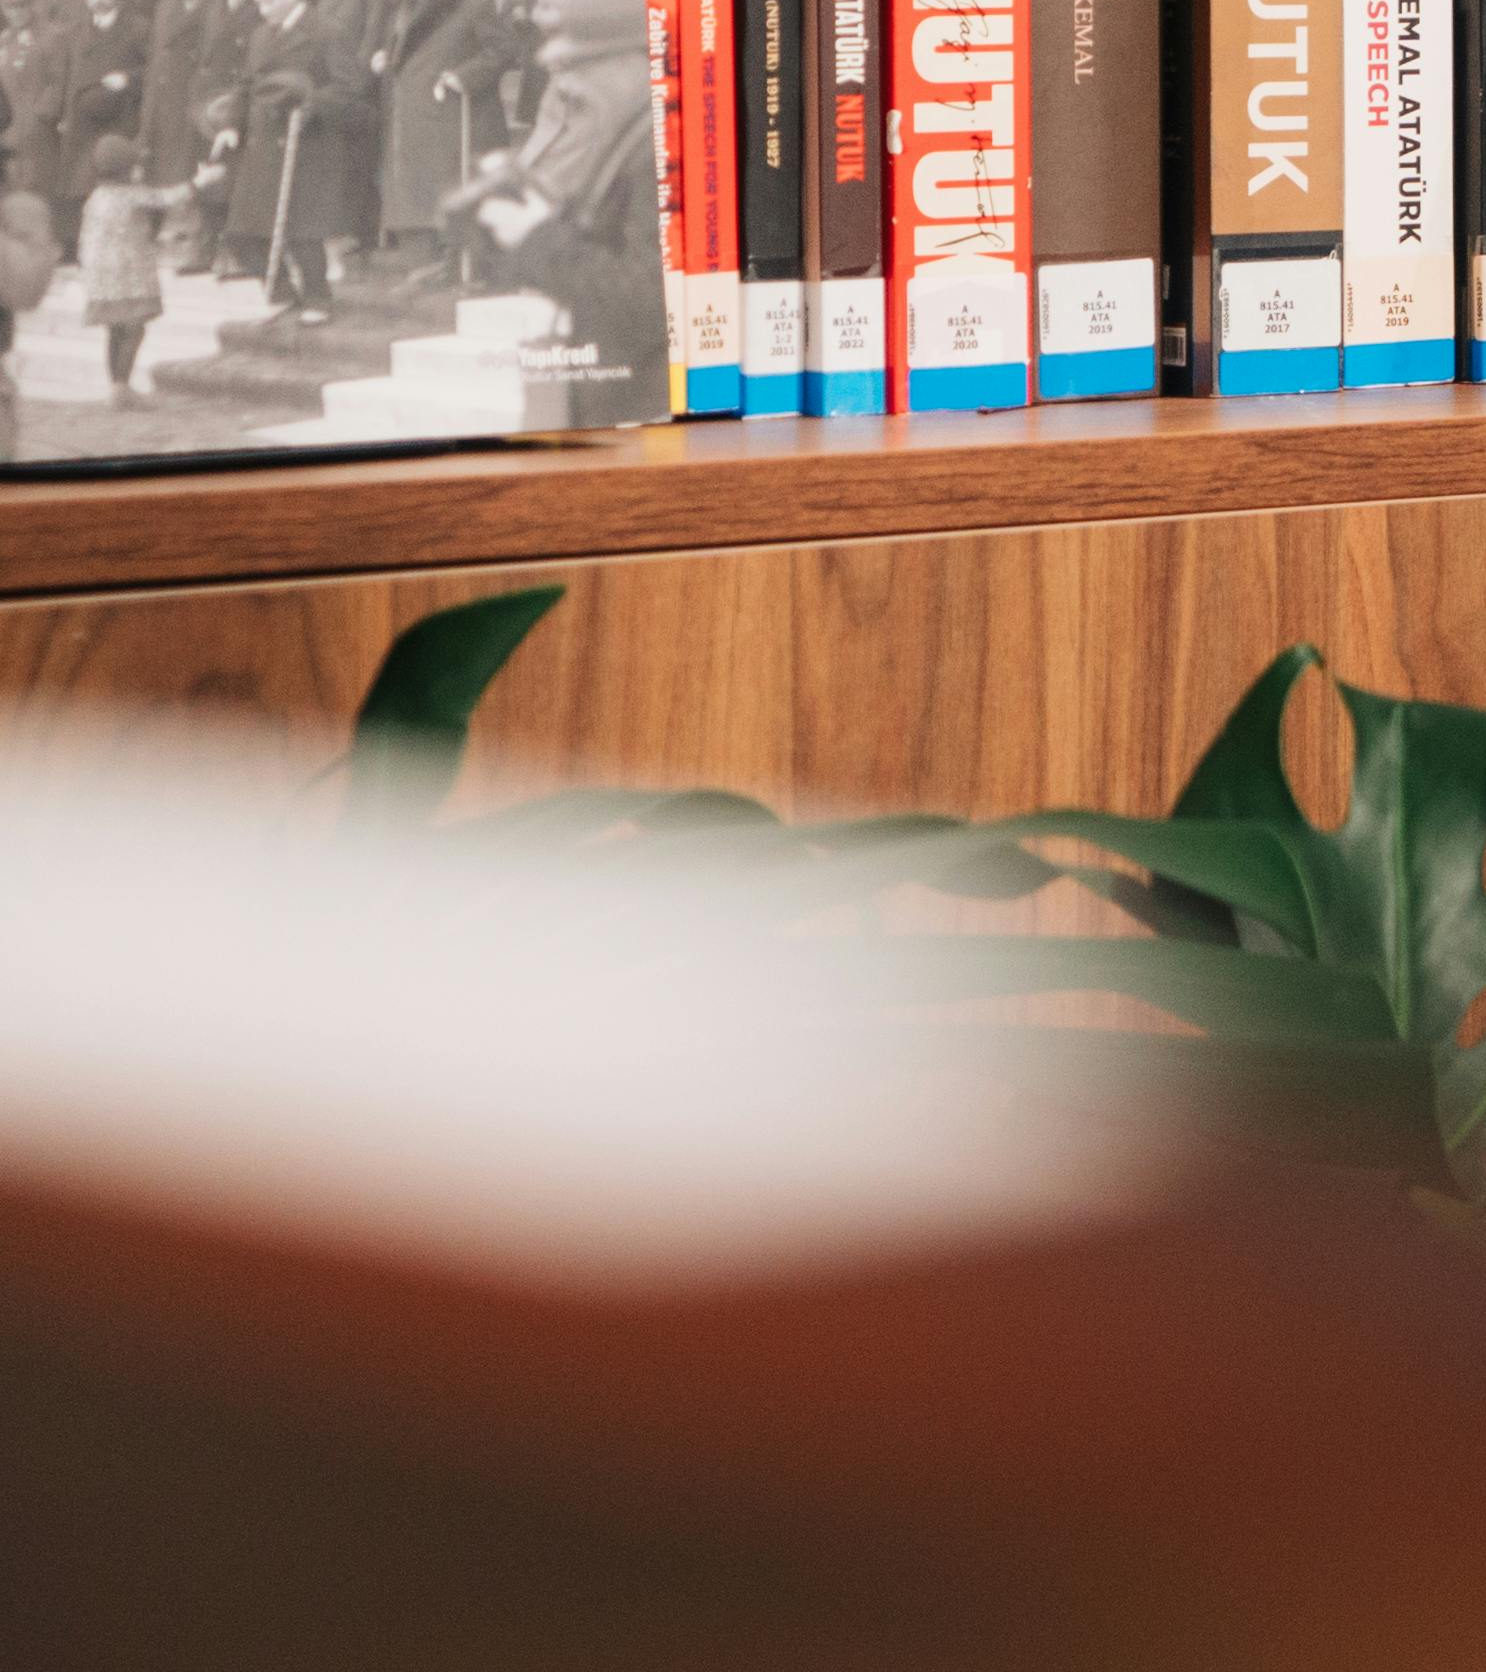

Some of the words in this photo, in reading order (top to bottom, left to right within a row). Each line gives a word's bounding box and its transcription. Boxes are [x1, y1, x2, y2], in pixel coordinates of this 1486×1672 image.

[765, 0, 780, 71] (NUTUK)
[1367, 1, 1389, 127] SPEECH
[766, 77, 780, 111] 1919
[837, 94, 865, 181] NUTUK
[766, 130, 780, 169] 1927
[1398, 95, 1425, 244] ATATÜRK
[1083, 301, 1117, 311] 815.41
[1260, 300, 1295, 311] 815.41
[1092, 313, 1110, 322] ATA
[1264, 323, 1290, 334] 2017
[1268, 313, 1288, 322] ATA
[1088, 324, 1113, 335] 2019
